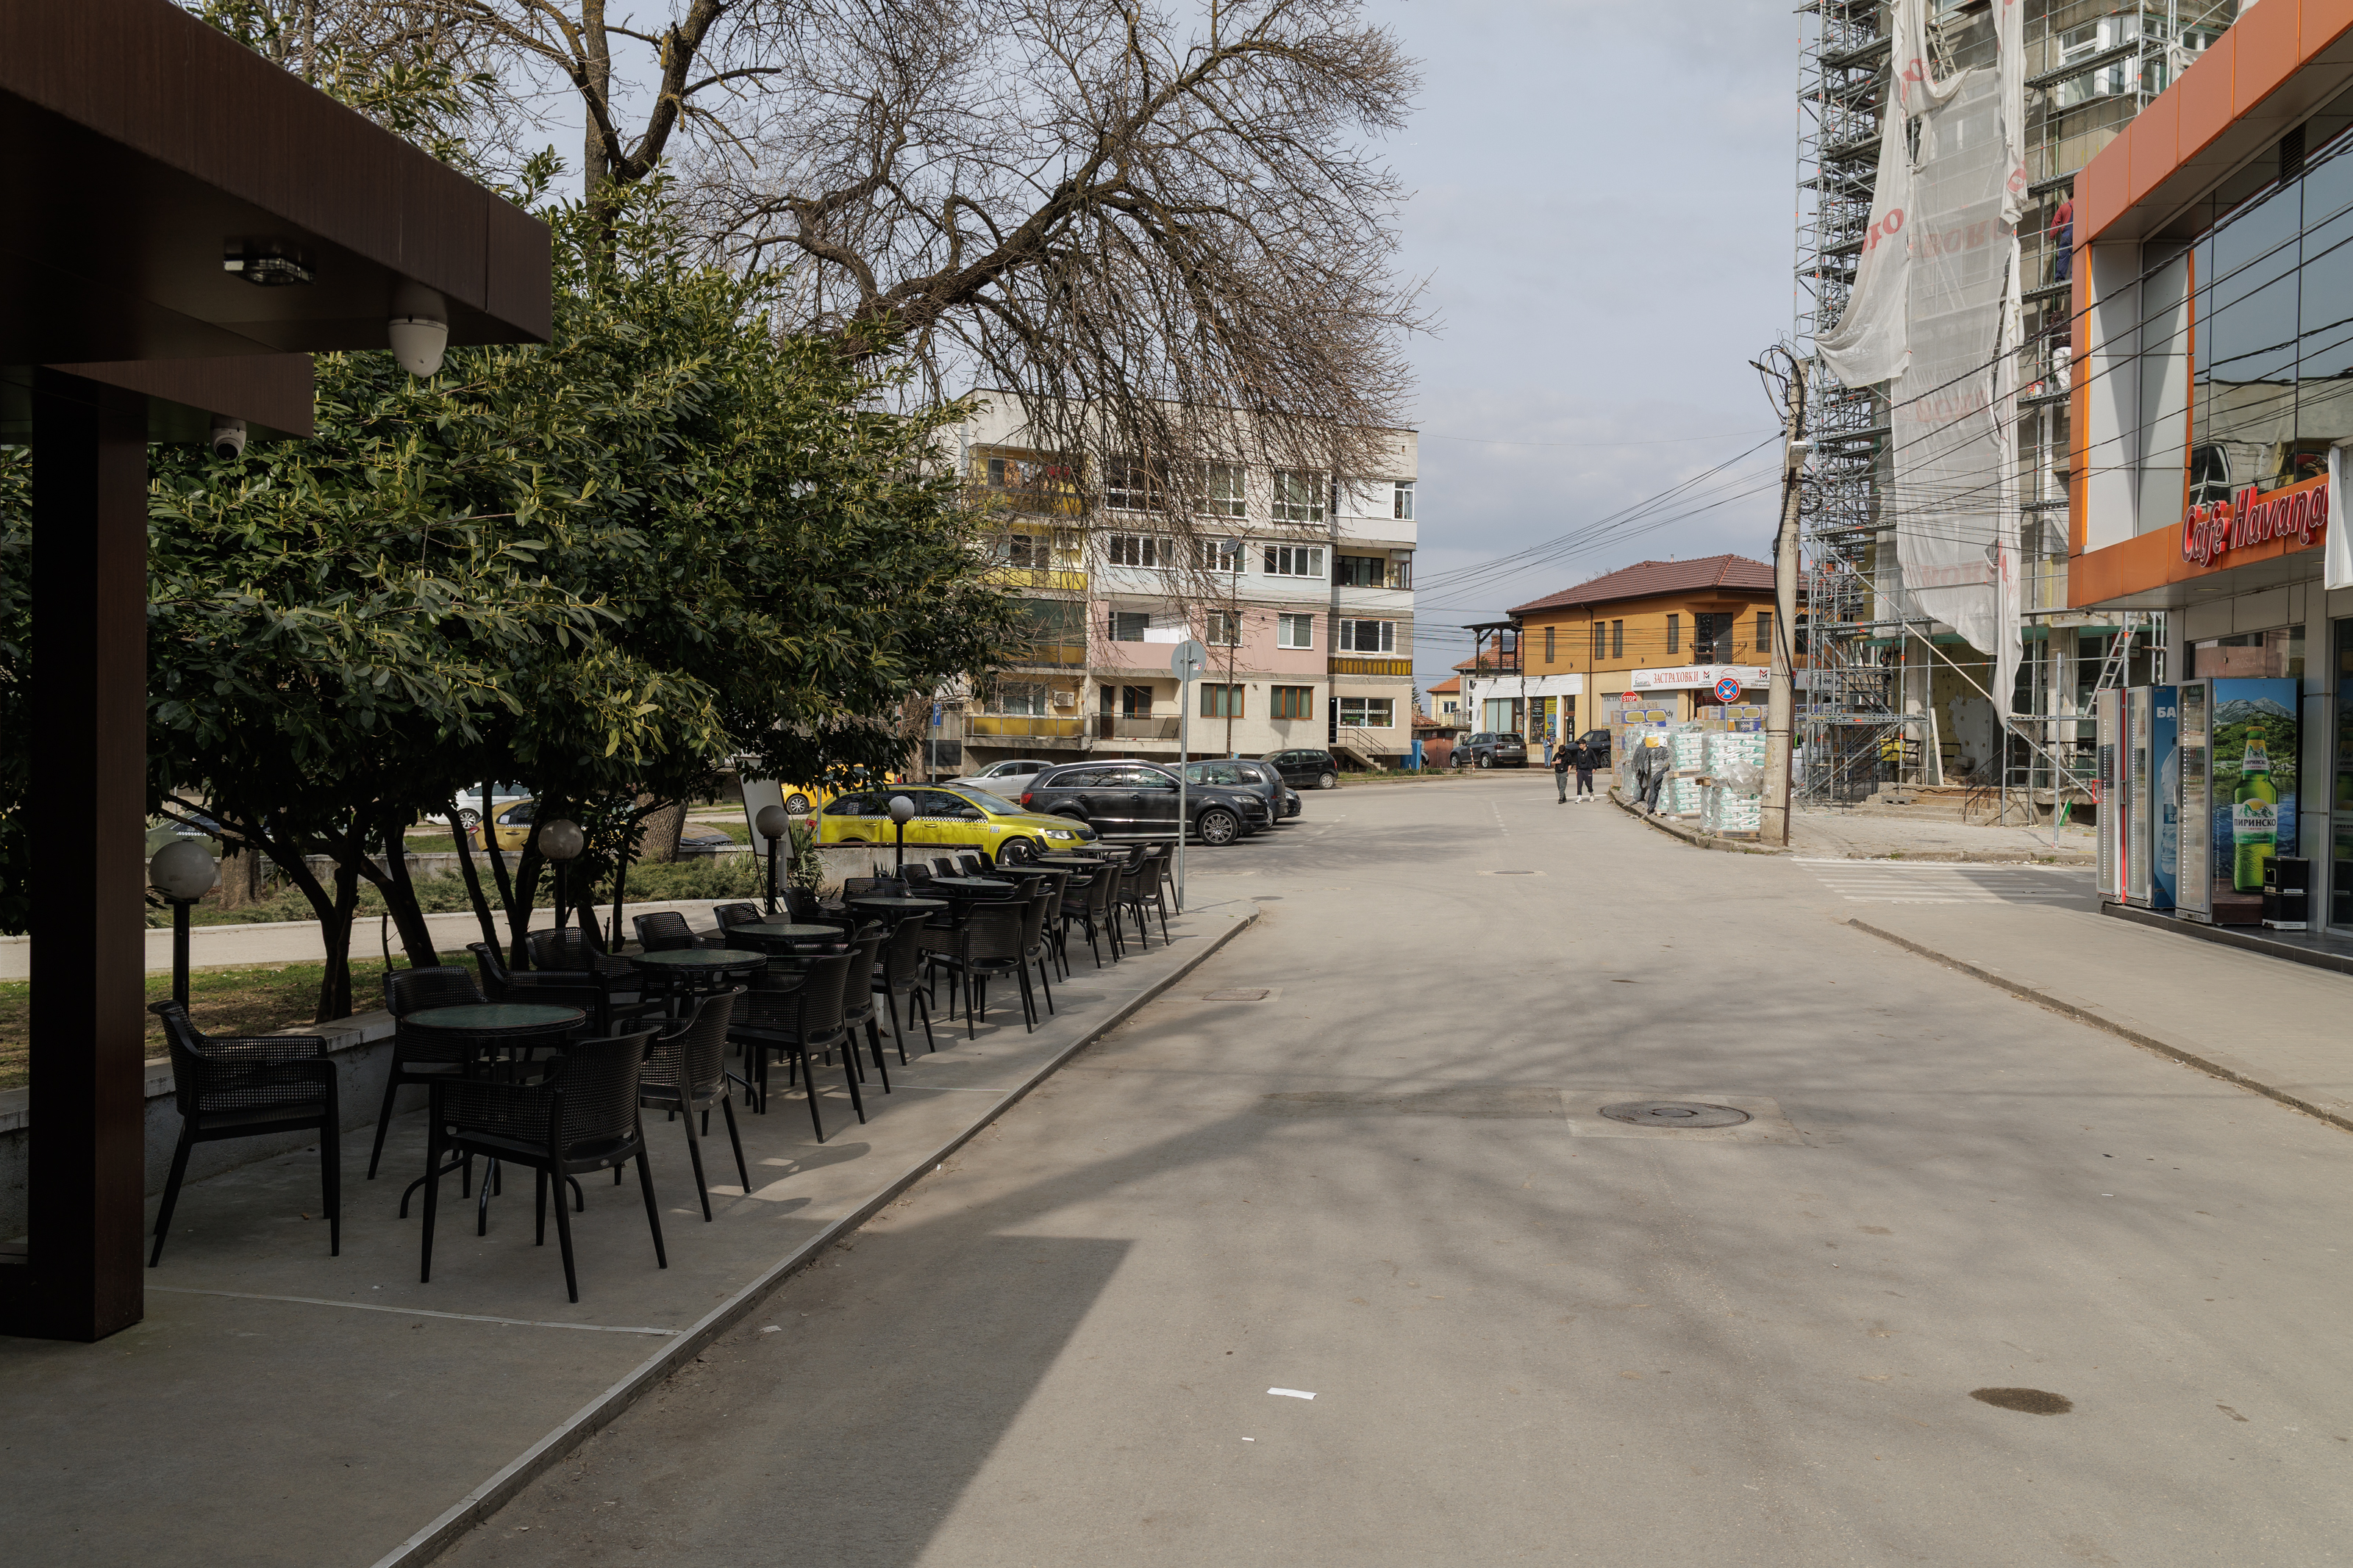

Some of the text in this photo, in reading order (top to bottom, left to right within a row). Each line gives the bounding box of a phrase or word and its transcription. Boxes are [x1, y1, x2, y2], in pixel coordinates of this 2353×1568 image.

[2181, 486, 2329, 568] Cafe Havana
[2230, 656, 2265, 669] MIROSLAVA
[1653, 670, 1699, 684] ЗАСТРАХОВКИ
[1817, 678, 1839, 687] seey
[1665, 709, 1674, 718] edy
[2156, 706, 2177, 718] БА
[2168, 814, 2177, 822] БА
[2234, 818, 2277, 827] ПИРИНСКО
